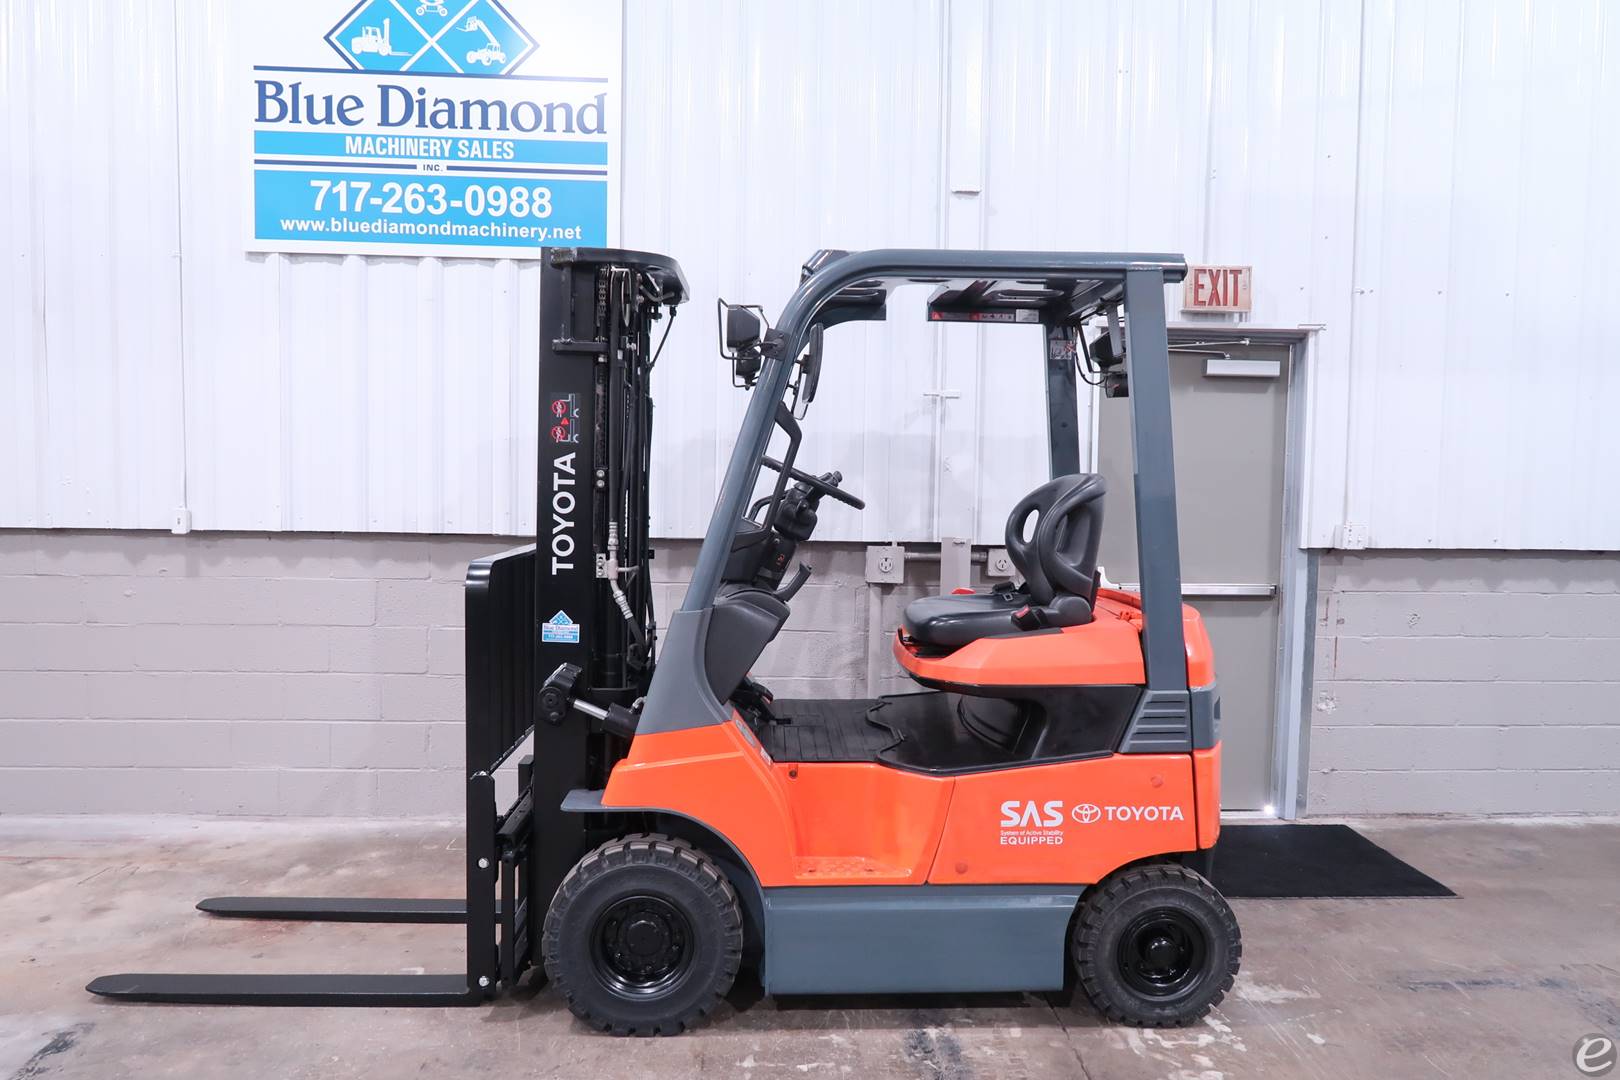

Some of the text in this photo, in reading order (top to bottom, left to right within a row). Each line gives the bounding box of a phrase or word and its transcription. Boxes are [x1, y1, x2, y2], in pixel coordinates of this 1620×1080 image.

[254, 79, 608, 135] Blue Diamond
[345, 136, 515, 160] MACHINERY SALES
[422, 164, 444, 172] INC.
[310, 180, 552, 218] 717-263-0988
[280, 217, 582, 242] www.bluediamondmachinery.net
[1193, 269, 1242, 306] EXIT
[551, 452, 577, 576] TOYOTA
[1000, 800, 1064, 827] SAS
[1104, 806, 1185, 821] TOYOTA
[1000, 836, 1064, 845] EQUIPPED
